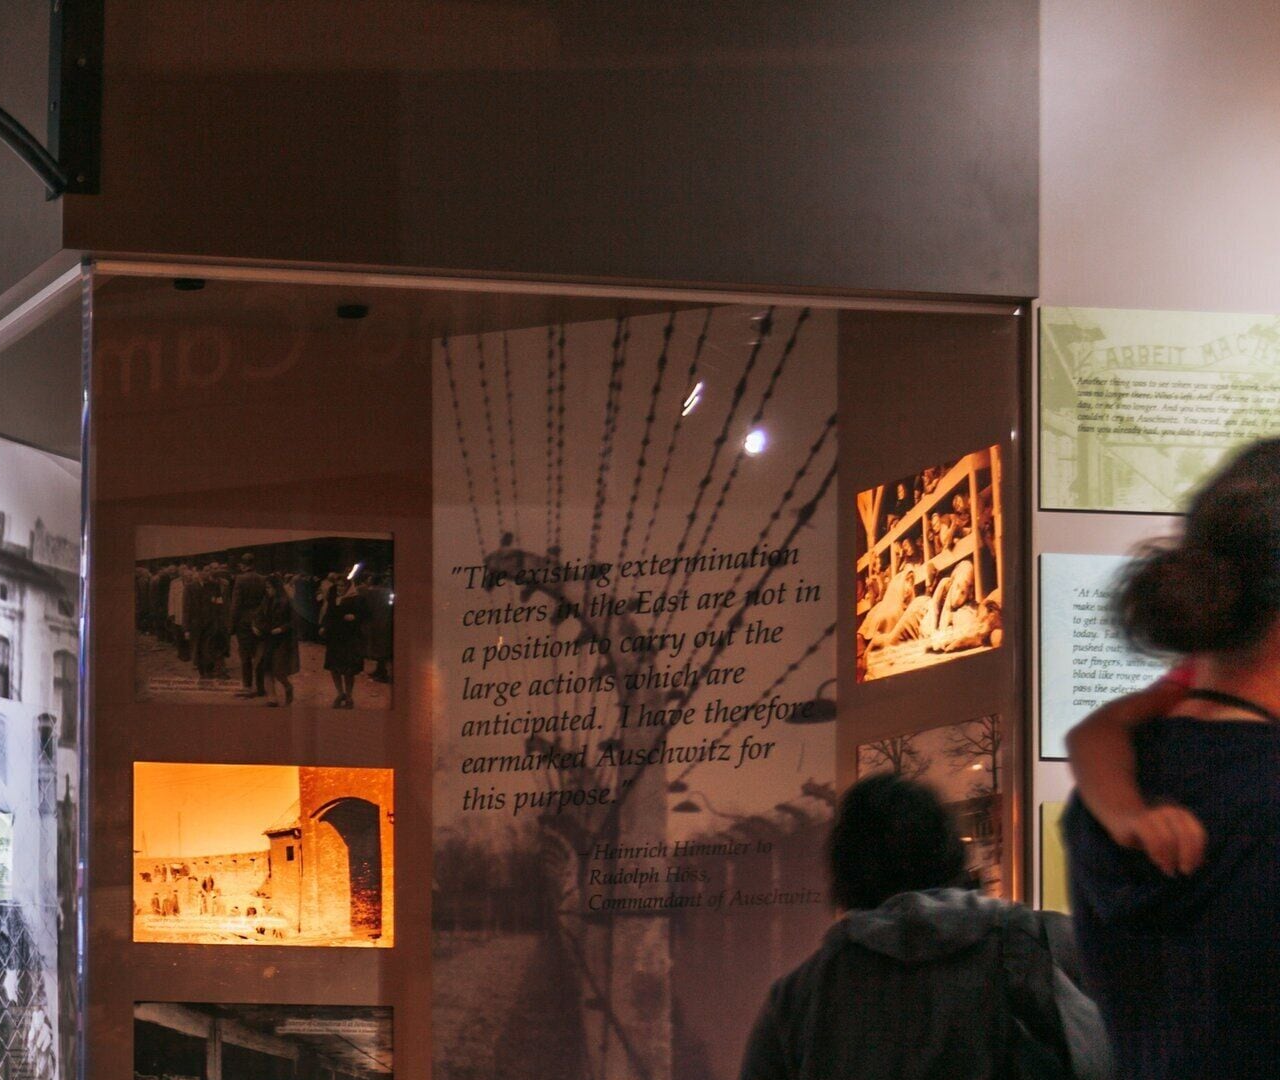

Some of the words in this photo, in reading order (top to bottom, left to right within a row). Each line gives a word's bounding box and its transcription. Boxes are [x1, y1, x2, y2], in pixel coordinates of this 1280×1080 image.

[451, 565, 507, 590] "The
[515, 558, 614, 588] existing
[620, 543, 800, 577] extermination
[462, 601, 548, 627] centers
[555, 596, 580, 619] in
[591, 593, 626, 617] the
[635, 590, 691, 615] East
[696, 589, 737, 610] are
[745, 583, 787, 606] not
[795, 579, 822, 603] in
[461, 644, 476, 664] a
[482, 635, 581, 670] position
[589, 634, 612, 655] to
[620, 632, 687, 659] carry
[693, 625, 737, 649] out
[744, 620, 784, 645] the
[462, 676, 522, 707] large
[528, 670, 616, 697] actions
[624, 665, 699, 690] which
[705, 666, 747, 686] are
[461, 706, 603, 741] anticipated.
[620, 704, 636, 729] I
[639, 704, 696, 728] have
[704, 695, 816, 729] therefore
[461, 744, 587, 775] earmarked
[595, 738, 731, 767] Auschwitz
[734, 735, 777, 769] for
[462, 786, 507, 811] this
[593, 840, 668, 861] Heinrich
[673, 839, 751, 858] Himmler
[756, 838, 773, 855] to
[589, 866, 660, 888] Rudolph
